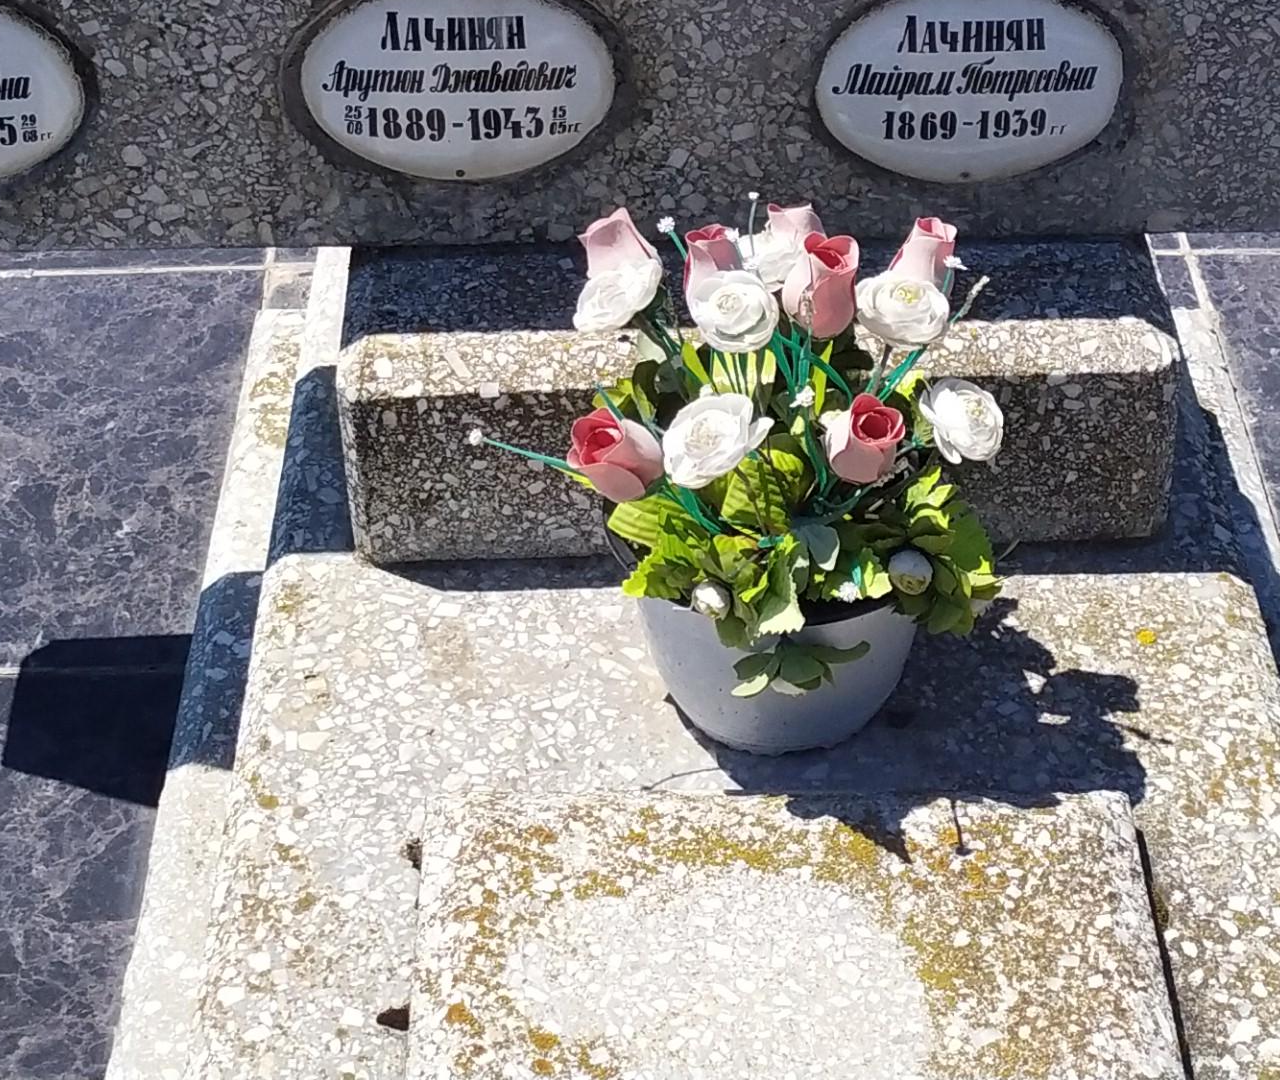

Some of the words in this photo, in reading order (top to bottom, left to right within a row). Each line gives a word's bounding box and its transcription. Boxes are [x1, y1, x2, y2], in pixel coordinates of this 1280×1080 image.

[380, 12, 526, 51] ЛАЧИНЯН
[897, 15, 1046, 54] ЛАЧИНЯН
[322, 60, 425, 101] Арутюн
[429, 60, 577, 93] Джавадович
[832, 63, 956, 101] Майрам
[956, 56, 1099, 102] Петросовна
